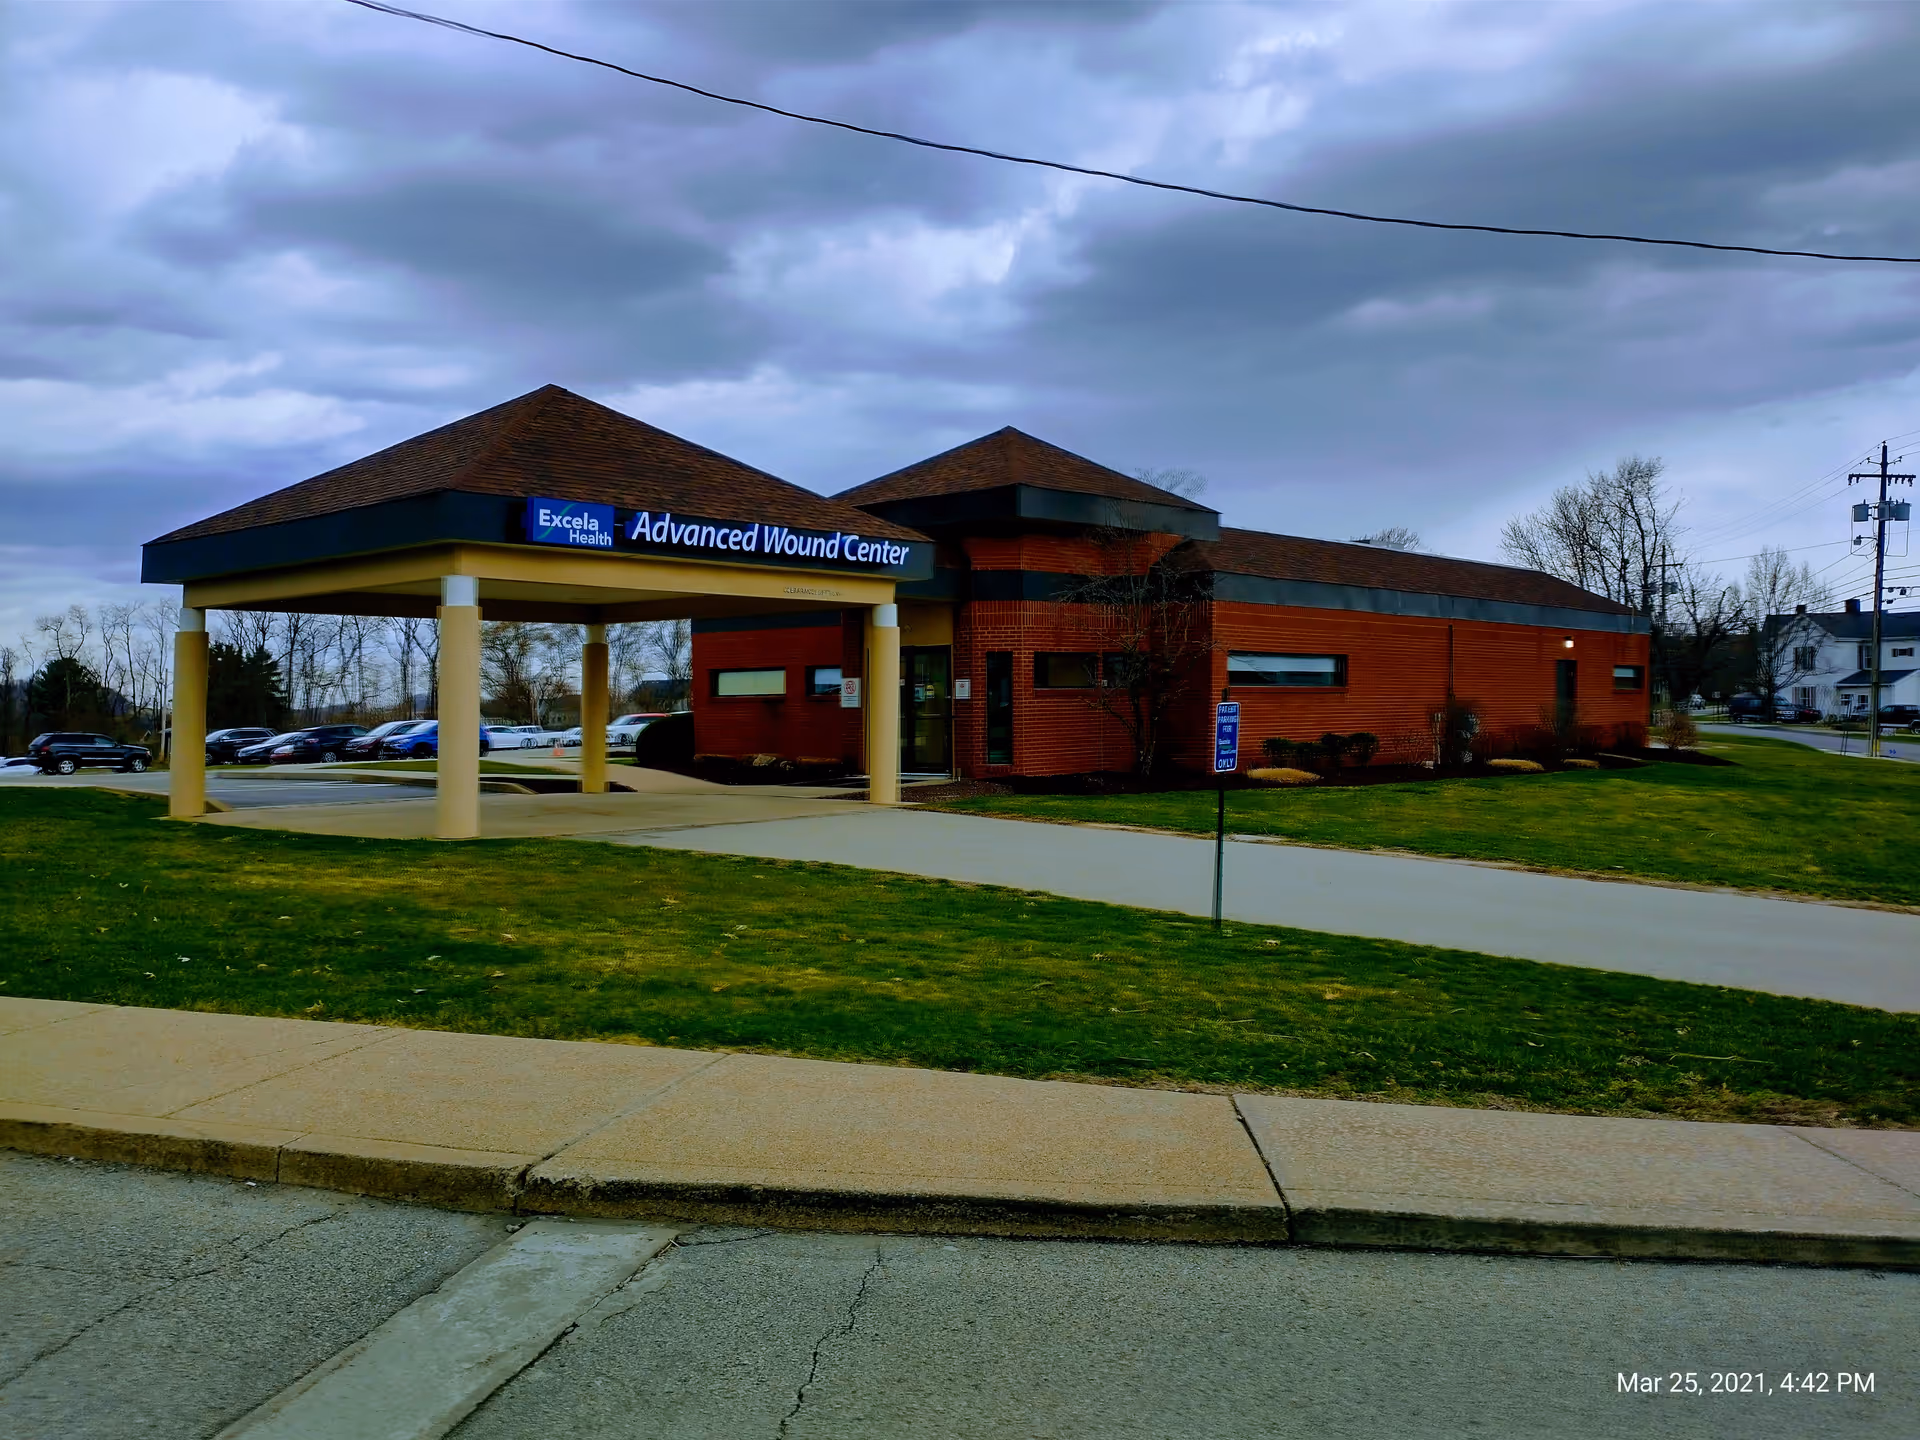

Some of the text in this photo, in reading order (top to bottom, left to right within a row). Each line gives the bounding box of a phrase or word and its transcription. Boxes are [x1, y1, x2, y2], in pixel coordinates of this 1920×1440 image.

[538, 508, 599, 531] Excela
[569, 529, 612, 546] Health
[631, 511, 910, 566] Advanced Wound Center
[1218, 758, 1234, 769] ONLY
